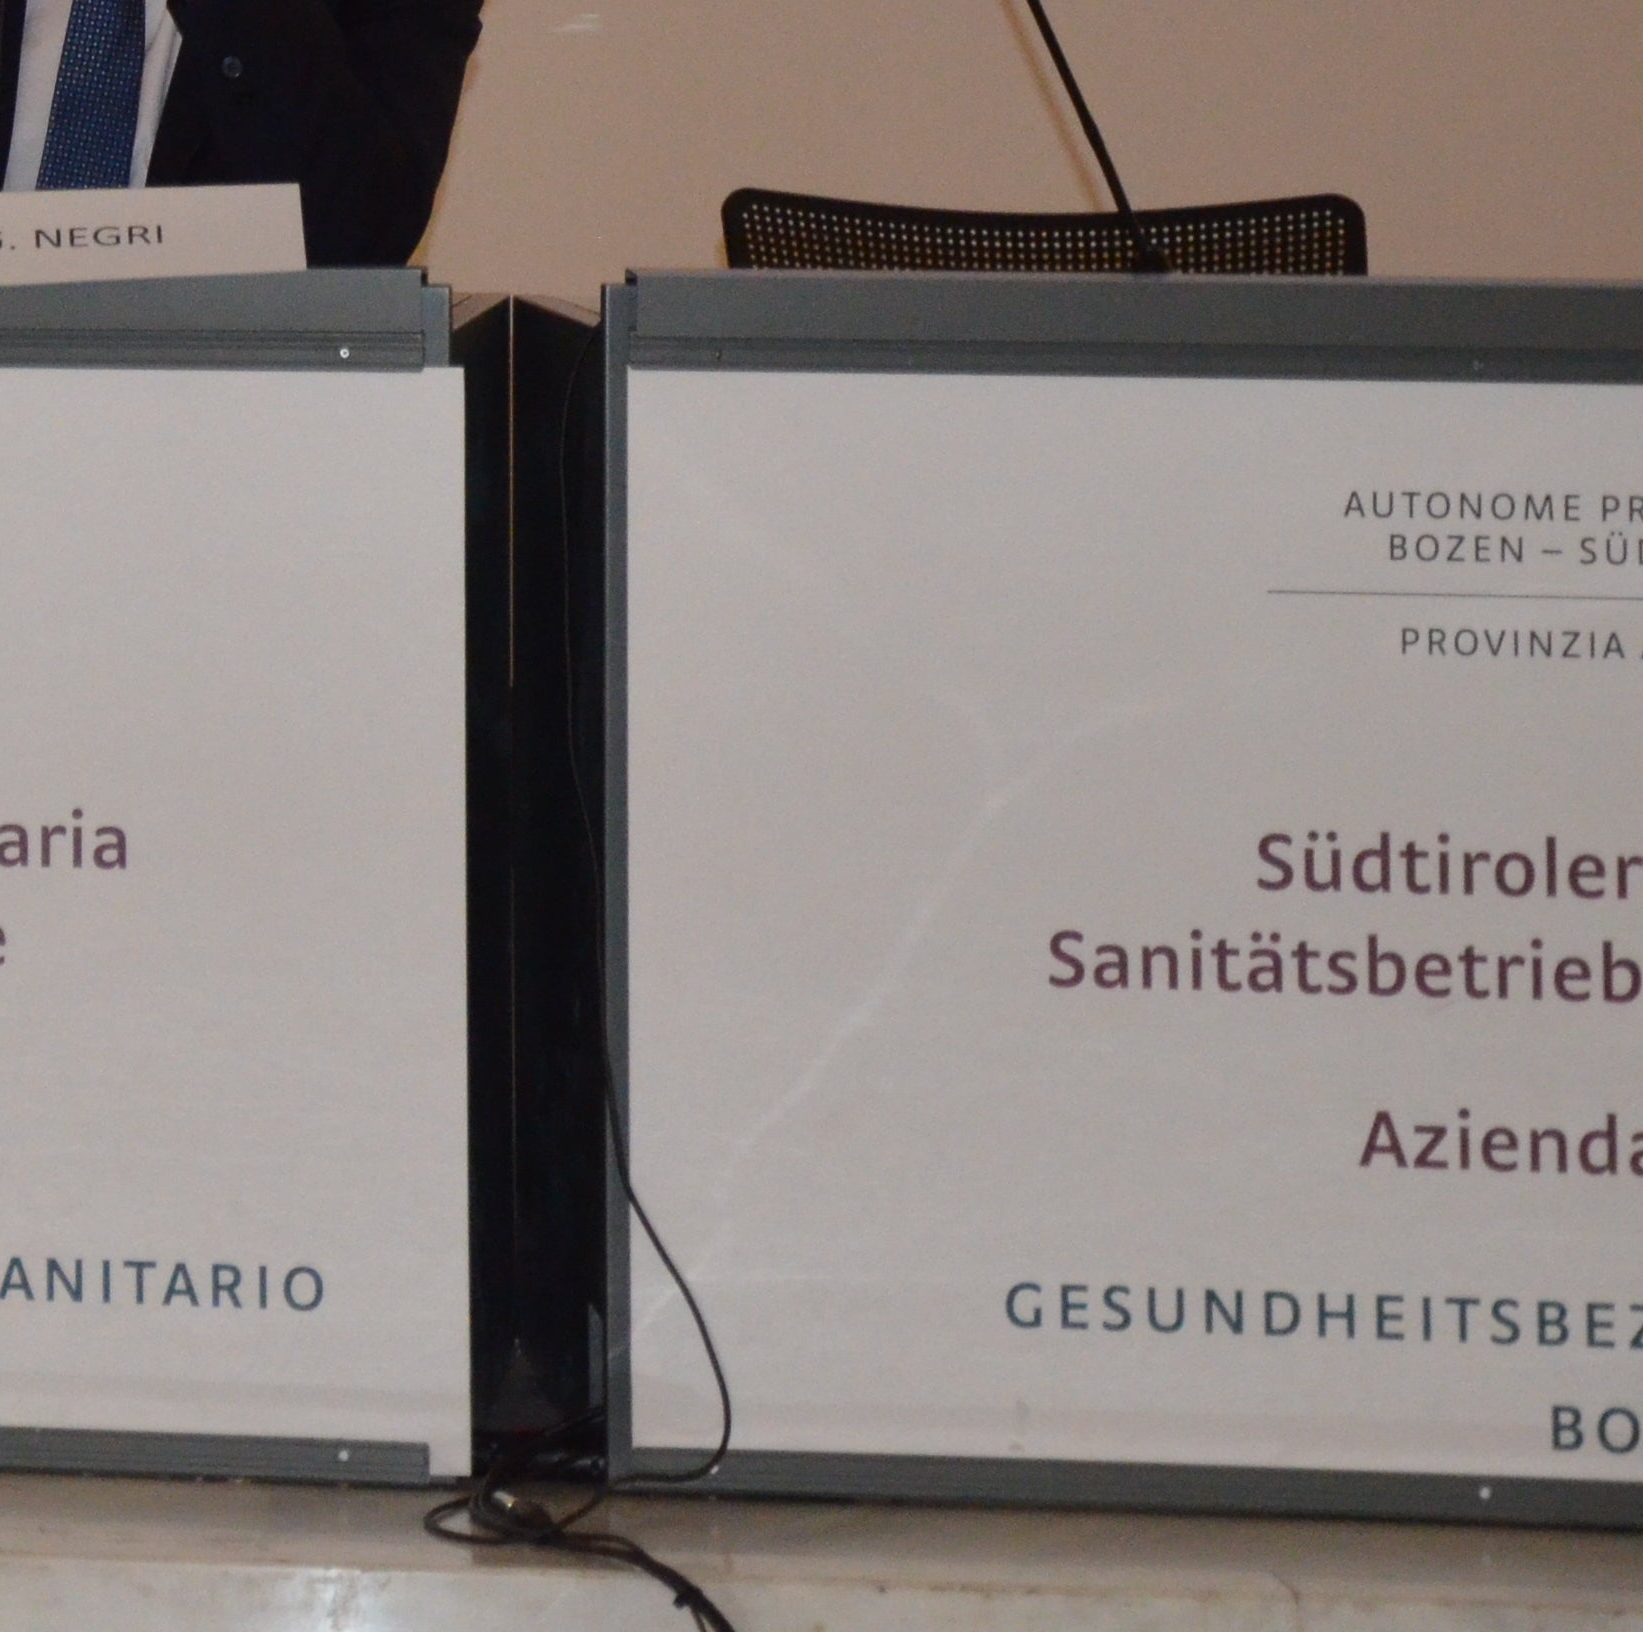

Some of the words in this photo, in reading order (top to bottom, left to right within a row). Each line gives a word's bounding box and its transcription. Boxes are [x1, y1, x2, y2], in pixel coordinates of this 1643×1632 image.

[34, 224, 163, 249] NEGRI
[1343, 490, 1581, 523] AUTONOME
[1388, 533, 1524, 564] BOZEN
[1579, 531, 1643, 566] SÜ
[1400, 627, 1626, 660] PROVINZIA
[1257, 830, 1643, 900] Südtiroler
[1048, 928, 1643, 1004] Sanitätsbetrieb
[1551, 1405, 1641, 1455] BO
